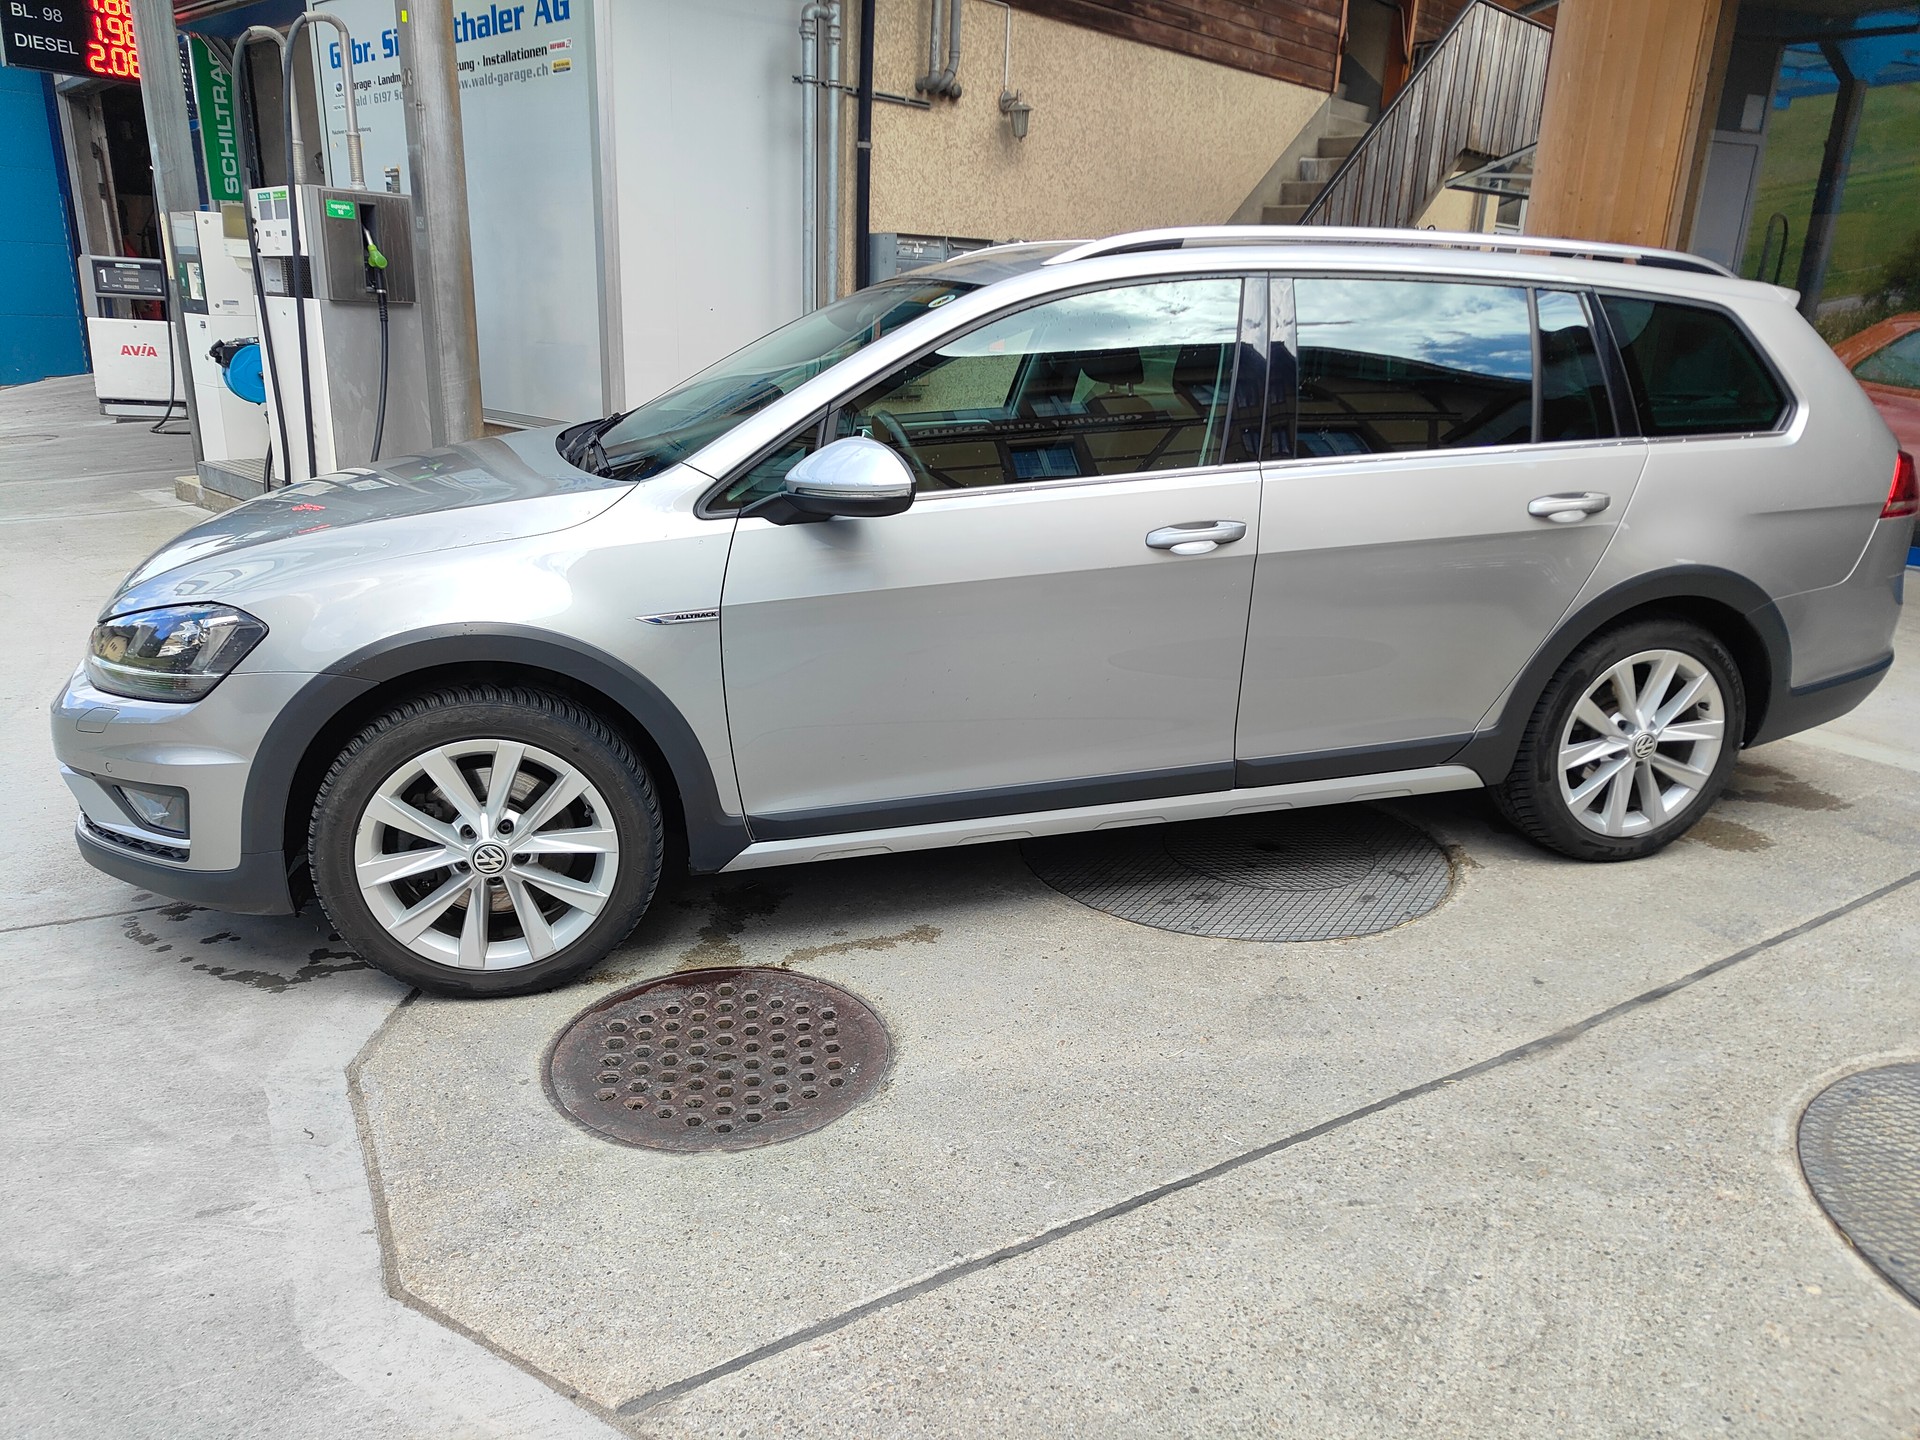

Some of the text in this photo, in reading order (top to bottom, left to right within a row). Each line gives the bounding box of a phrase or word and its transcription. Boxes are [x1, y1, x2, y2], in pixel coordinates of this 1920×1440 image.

[10, 2, 38, 19] BL.
[42, 7, 63, 22] 98
[14, 32, 80, 55] DIESEL
[329, 38, 376, 69] Gbr.
[533, 0, 571, 26] AG
[353, 79, 372, 91] arage
[482, 45, 548, 67] Installationen
[373, 90, 392, 104] 6197
[675, 611, 717, 620] ALLTRACK
